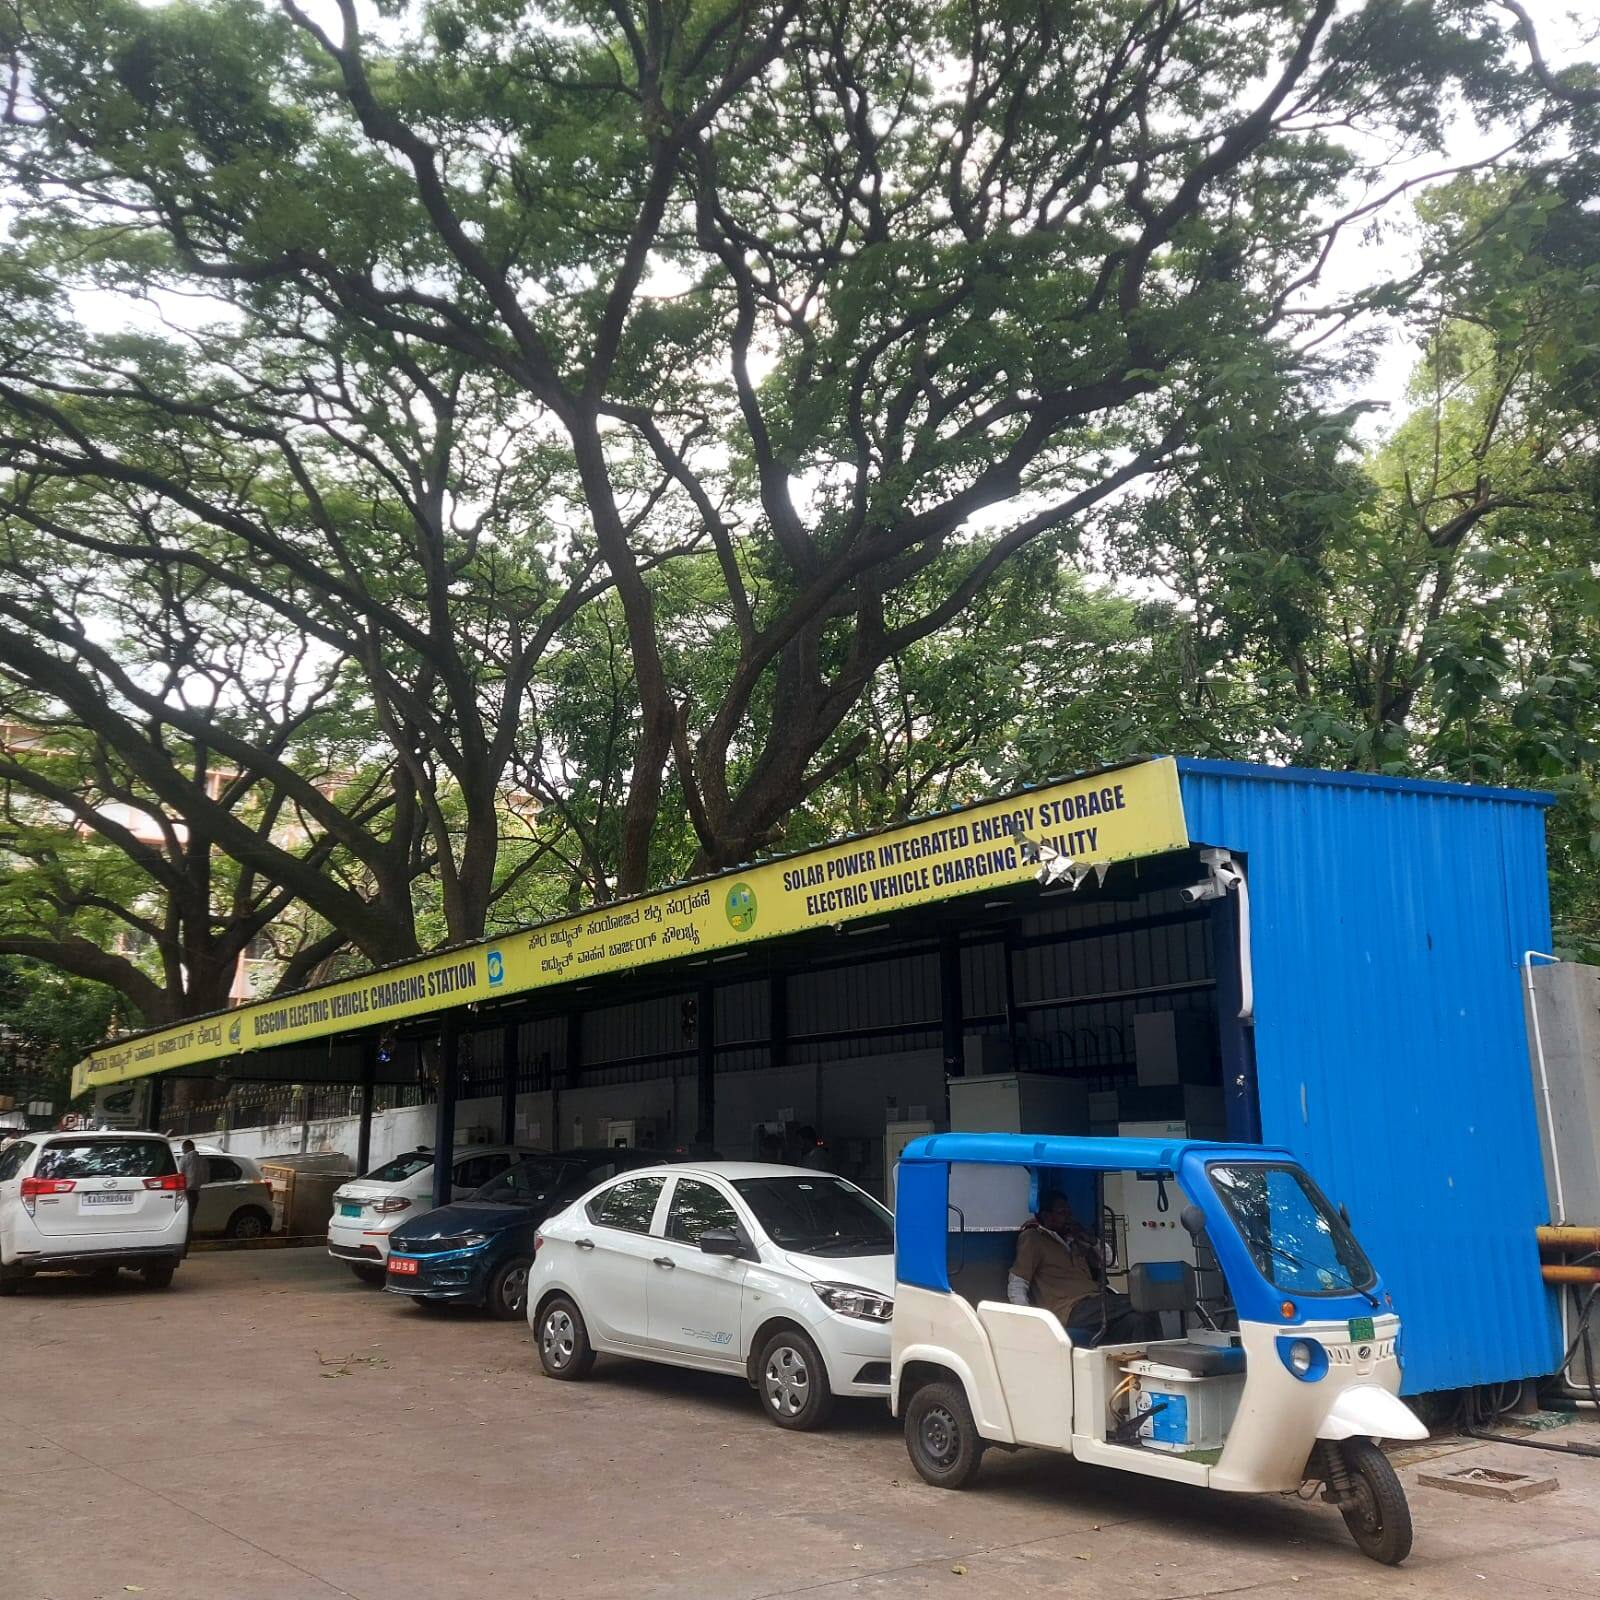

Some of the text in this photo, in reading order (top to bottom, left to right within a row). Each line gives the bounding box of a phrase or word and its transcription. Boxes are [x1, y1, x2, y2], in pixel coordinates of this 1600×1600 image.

[783, 785, 1126, 891] SOLAR POWER INTEGRATED ENERGY STORAGE
[807, 887, 868, 915] ELECTRIC
[870, 870, 929, 900] VEHICLE
[932, 847, 1016, 887] CHARGING
[255, 962, 476, 1035] BESCOM ELECTRIC VEHICLE CHARGING STATION
